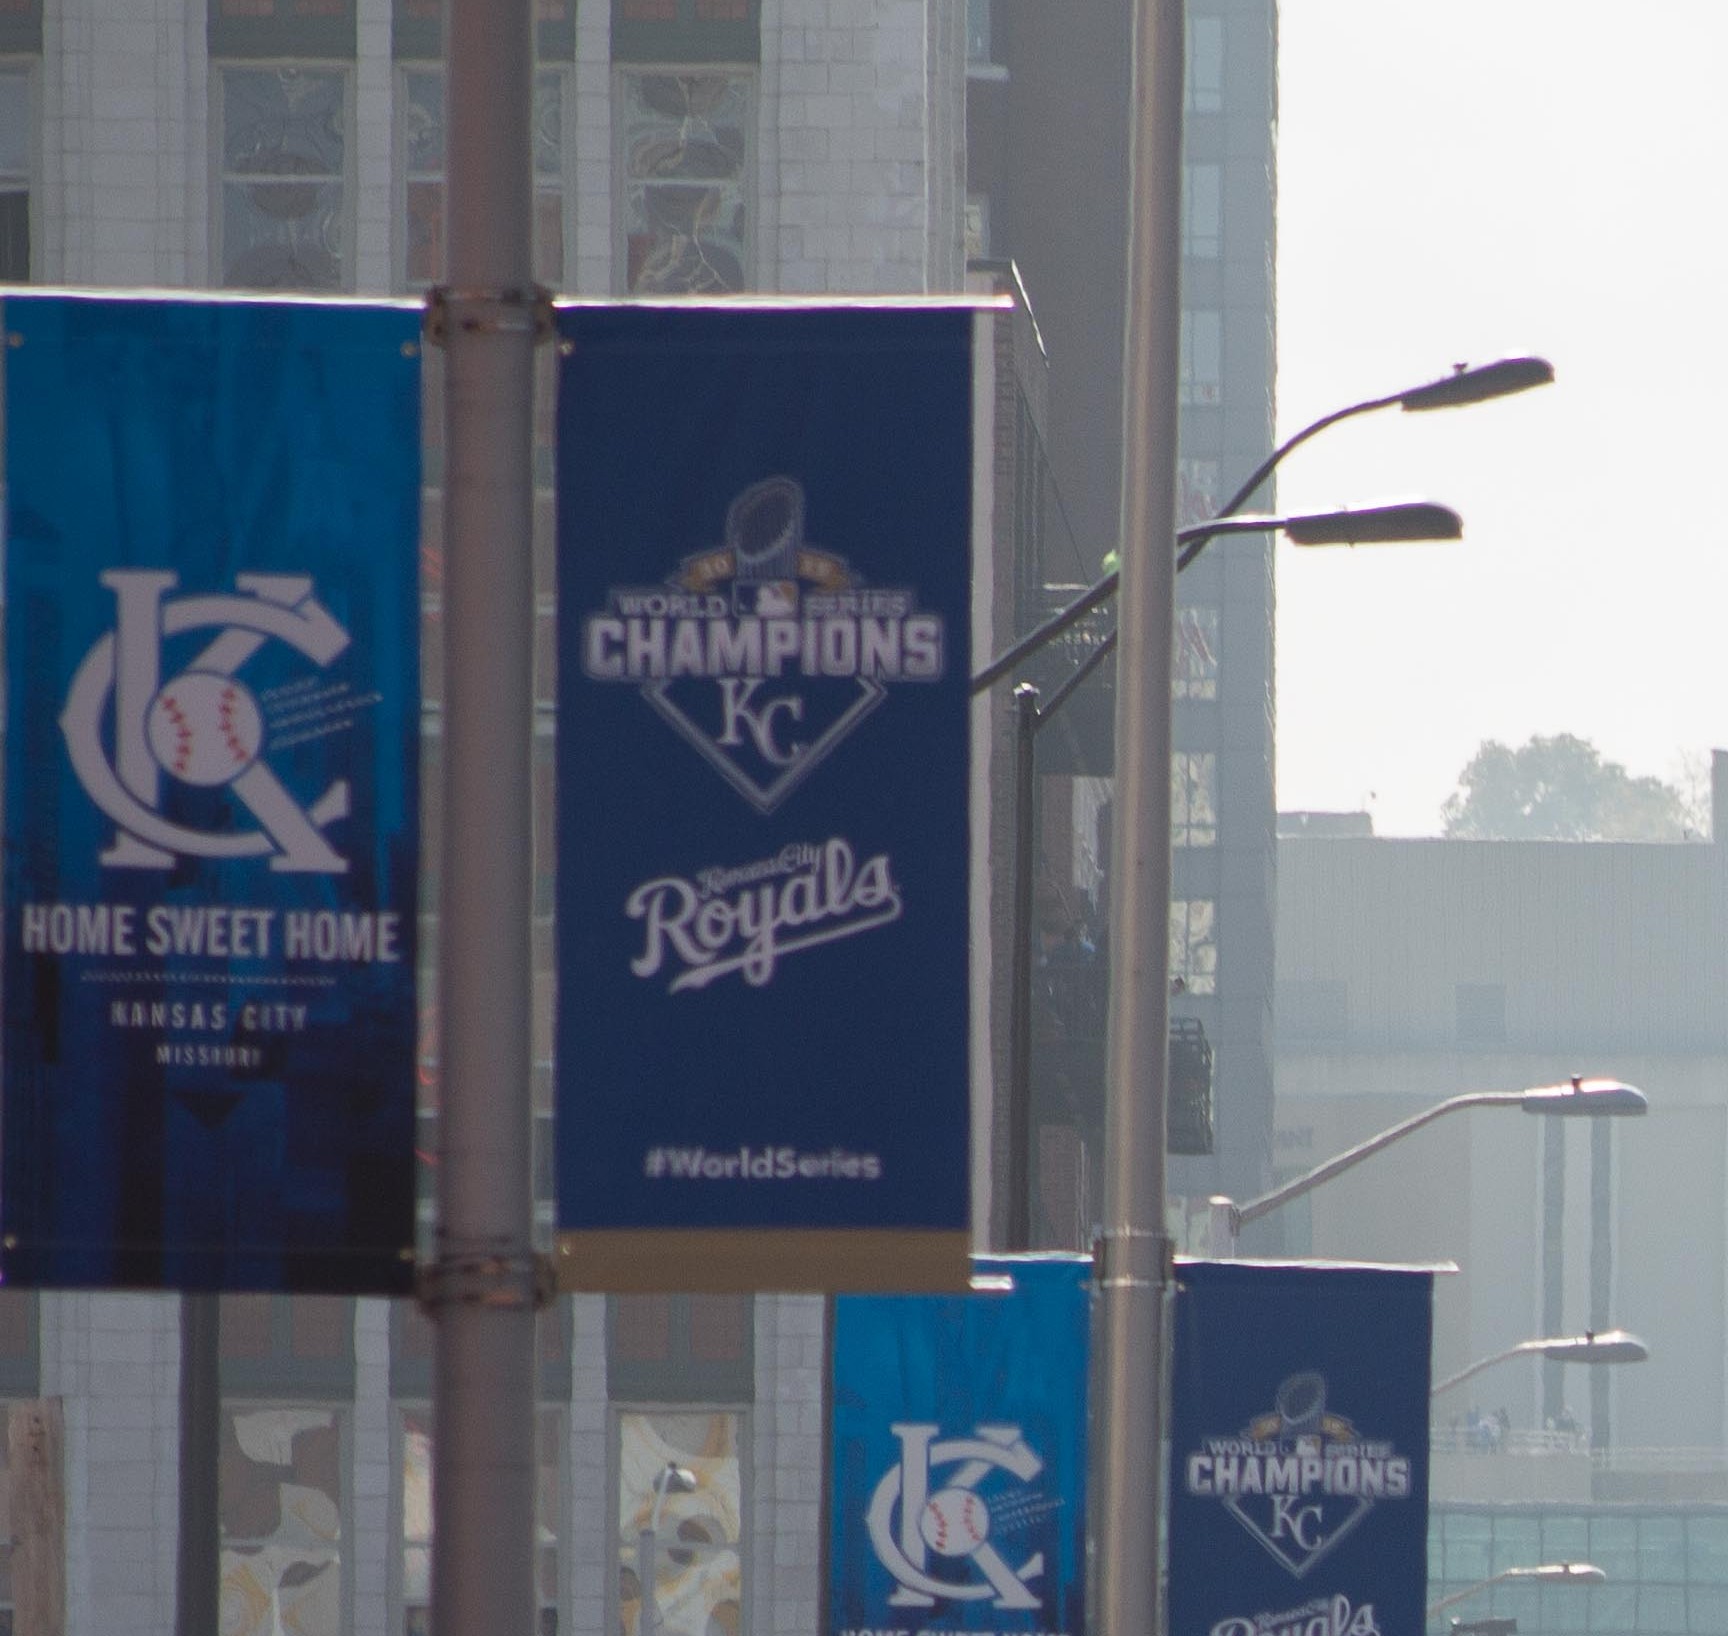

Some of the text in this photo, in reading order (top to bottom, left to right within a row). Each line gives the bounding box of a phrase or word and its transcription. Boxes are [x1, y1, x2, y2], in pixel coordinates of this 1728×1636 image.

[614, 592, 729, 619] WORLD
[585, 615, 942, 680] CHAMPIONS
[716, 676, 803, 766] KC
[22, 905, 400, 963] HOME SWEET HOME
[625, 837, 902, 995] Royals
[110, 999, 310, 1032] KANSAS CITY
[155, 1044, 262, 1069] MISSOURI
[644, 1147, 883, 1180] #WorldSeries
[1203, 1439, 1276, 1457] WORLD
[1187, 1453, 1411, 1498] CHAMPIONS
[1271, 1494, 1324, 1553] KC
